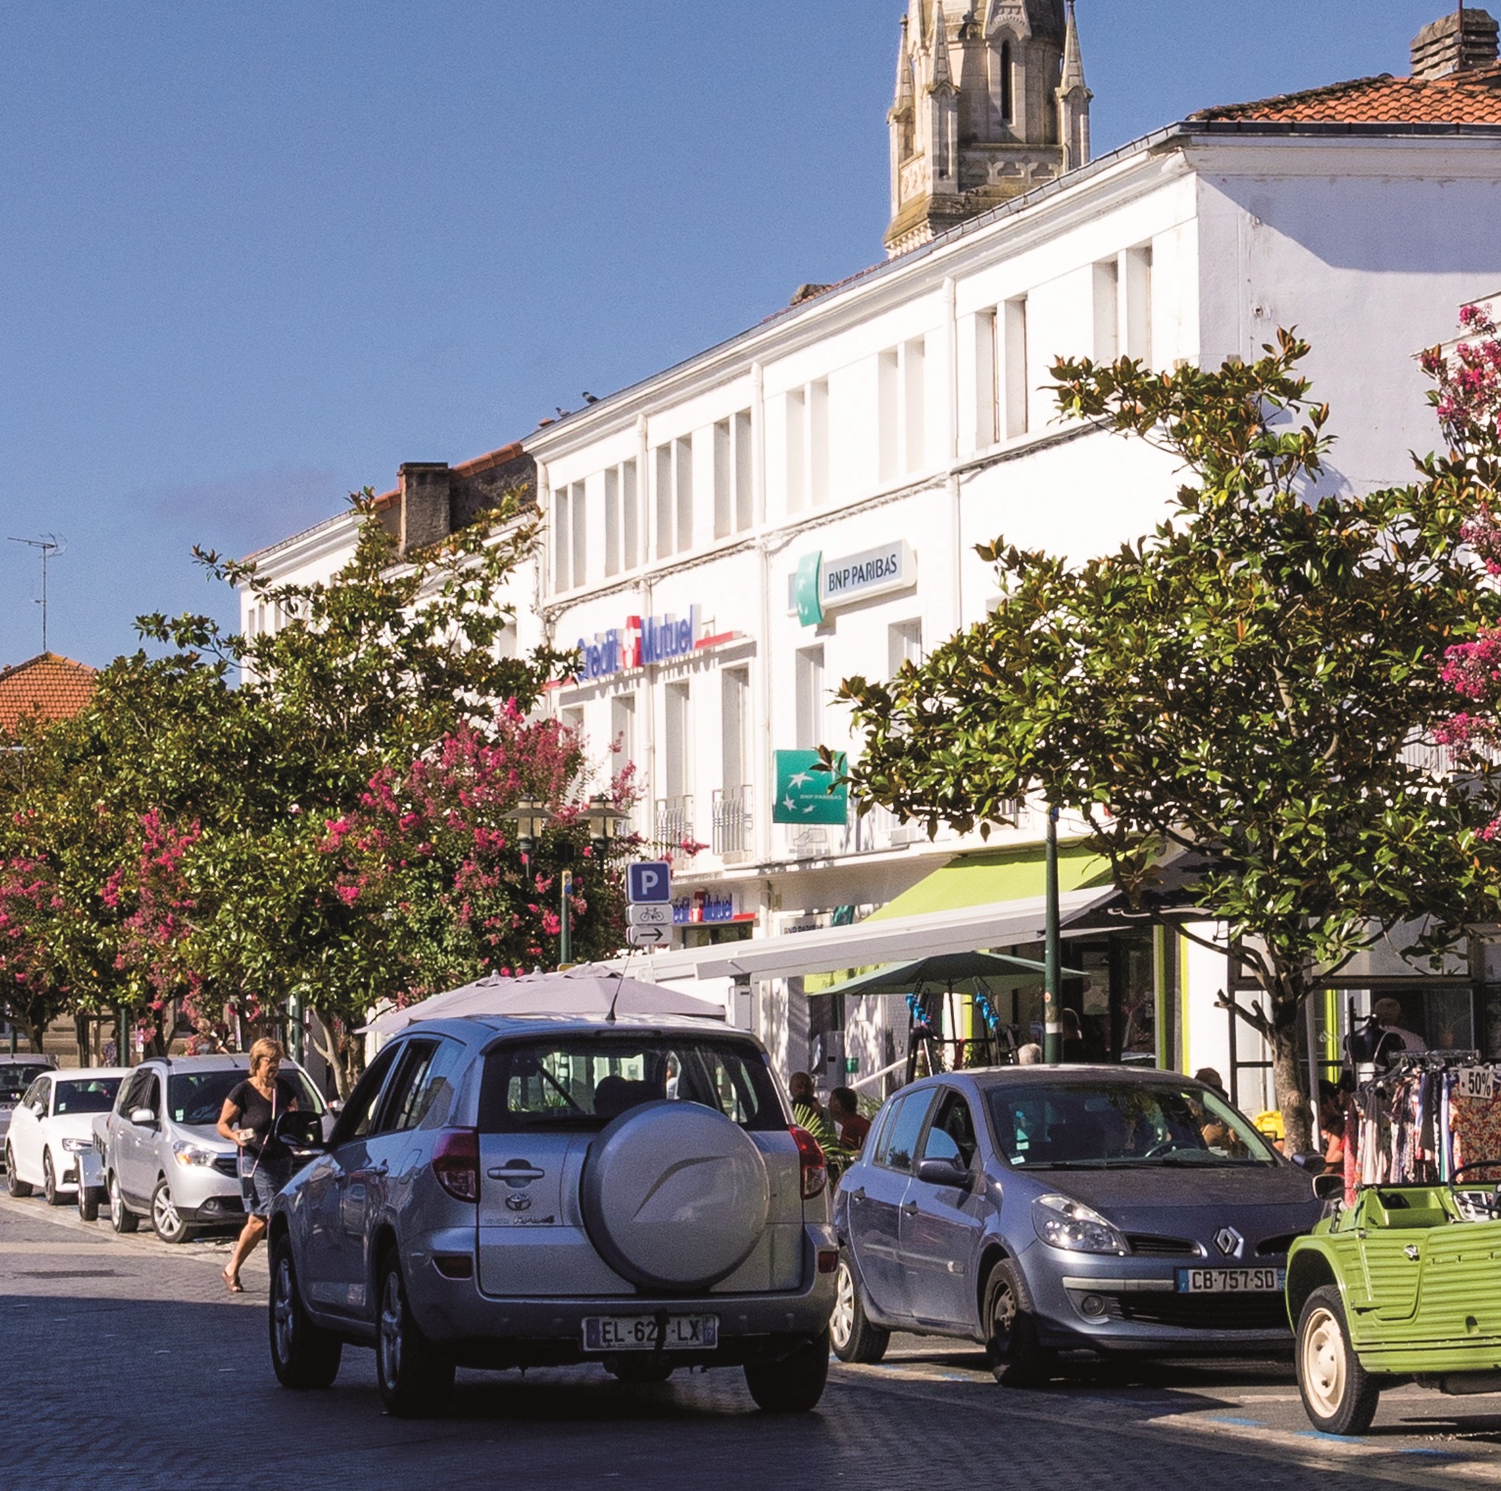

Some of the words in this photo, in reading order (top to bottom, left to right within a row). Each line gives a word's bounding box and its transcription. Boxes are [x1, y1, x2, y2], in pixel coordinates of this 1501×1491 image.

[828, 568, 851, 592] BNP
[851, 553, 898, 586] PARIBAS
[641, 604, 694, 665] Mutuel
[640, 869, 659, 896] P
[1192, 1269, 1275, 1290] CB-757-SD
[601, 1320, 700, 1343] EL-62-LX
